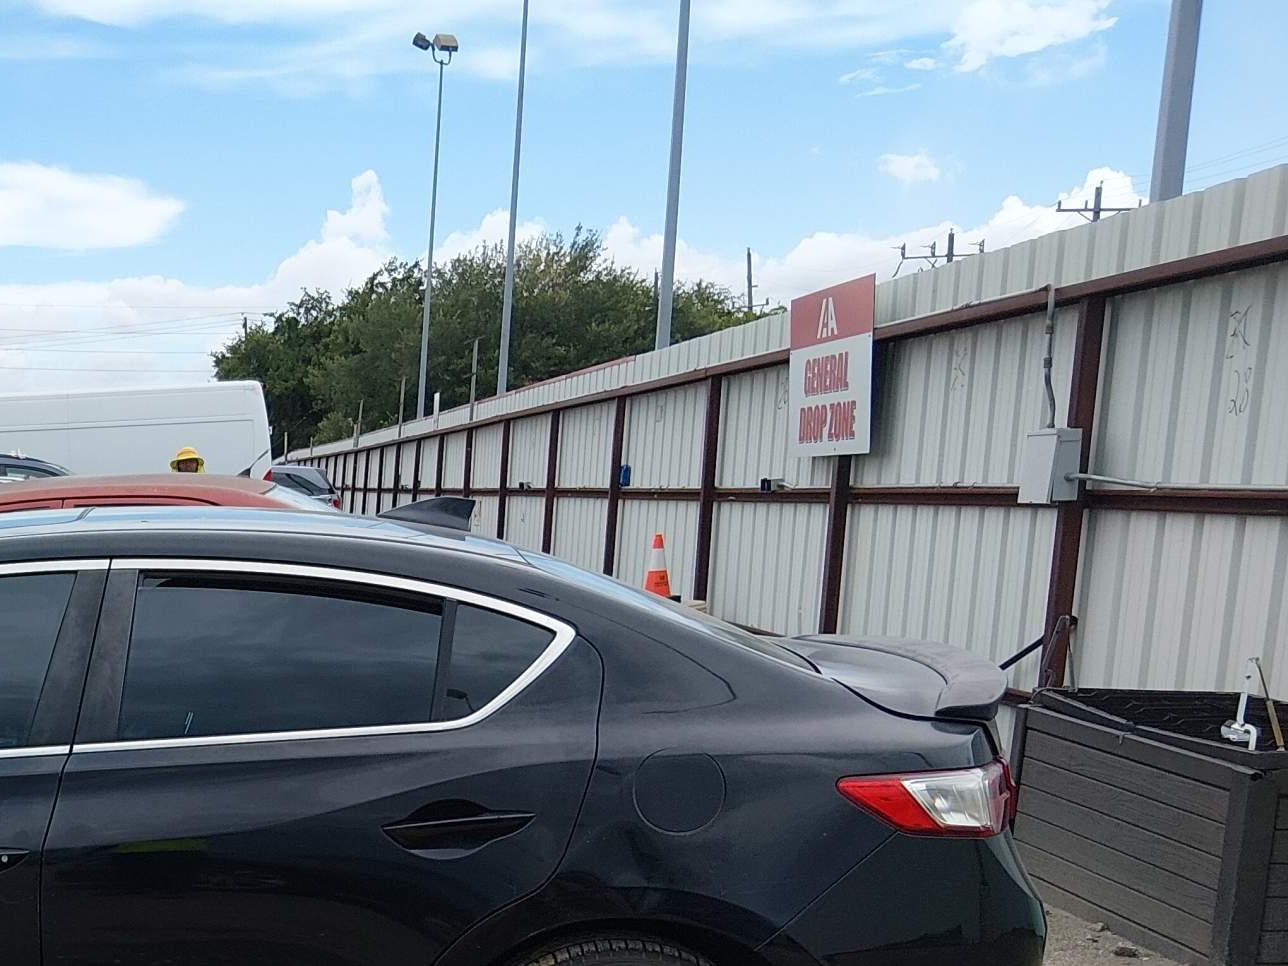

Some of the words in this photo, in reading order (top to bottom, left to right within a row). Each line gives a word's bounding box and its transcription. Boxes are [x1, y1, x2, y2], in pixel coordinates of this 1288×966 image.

[804, 352, 849, 397] GENERAL
[798, 404, 827, 444] DROP
[827, 400, 857, 441] ZONE
